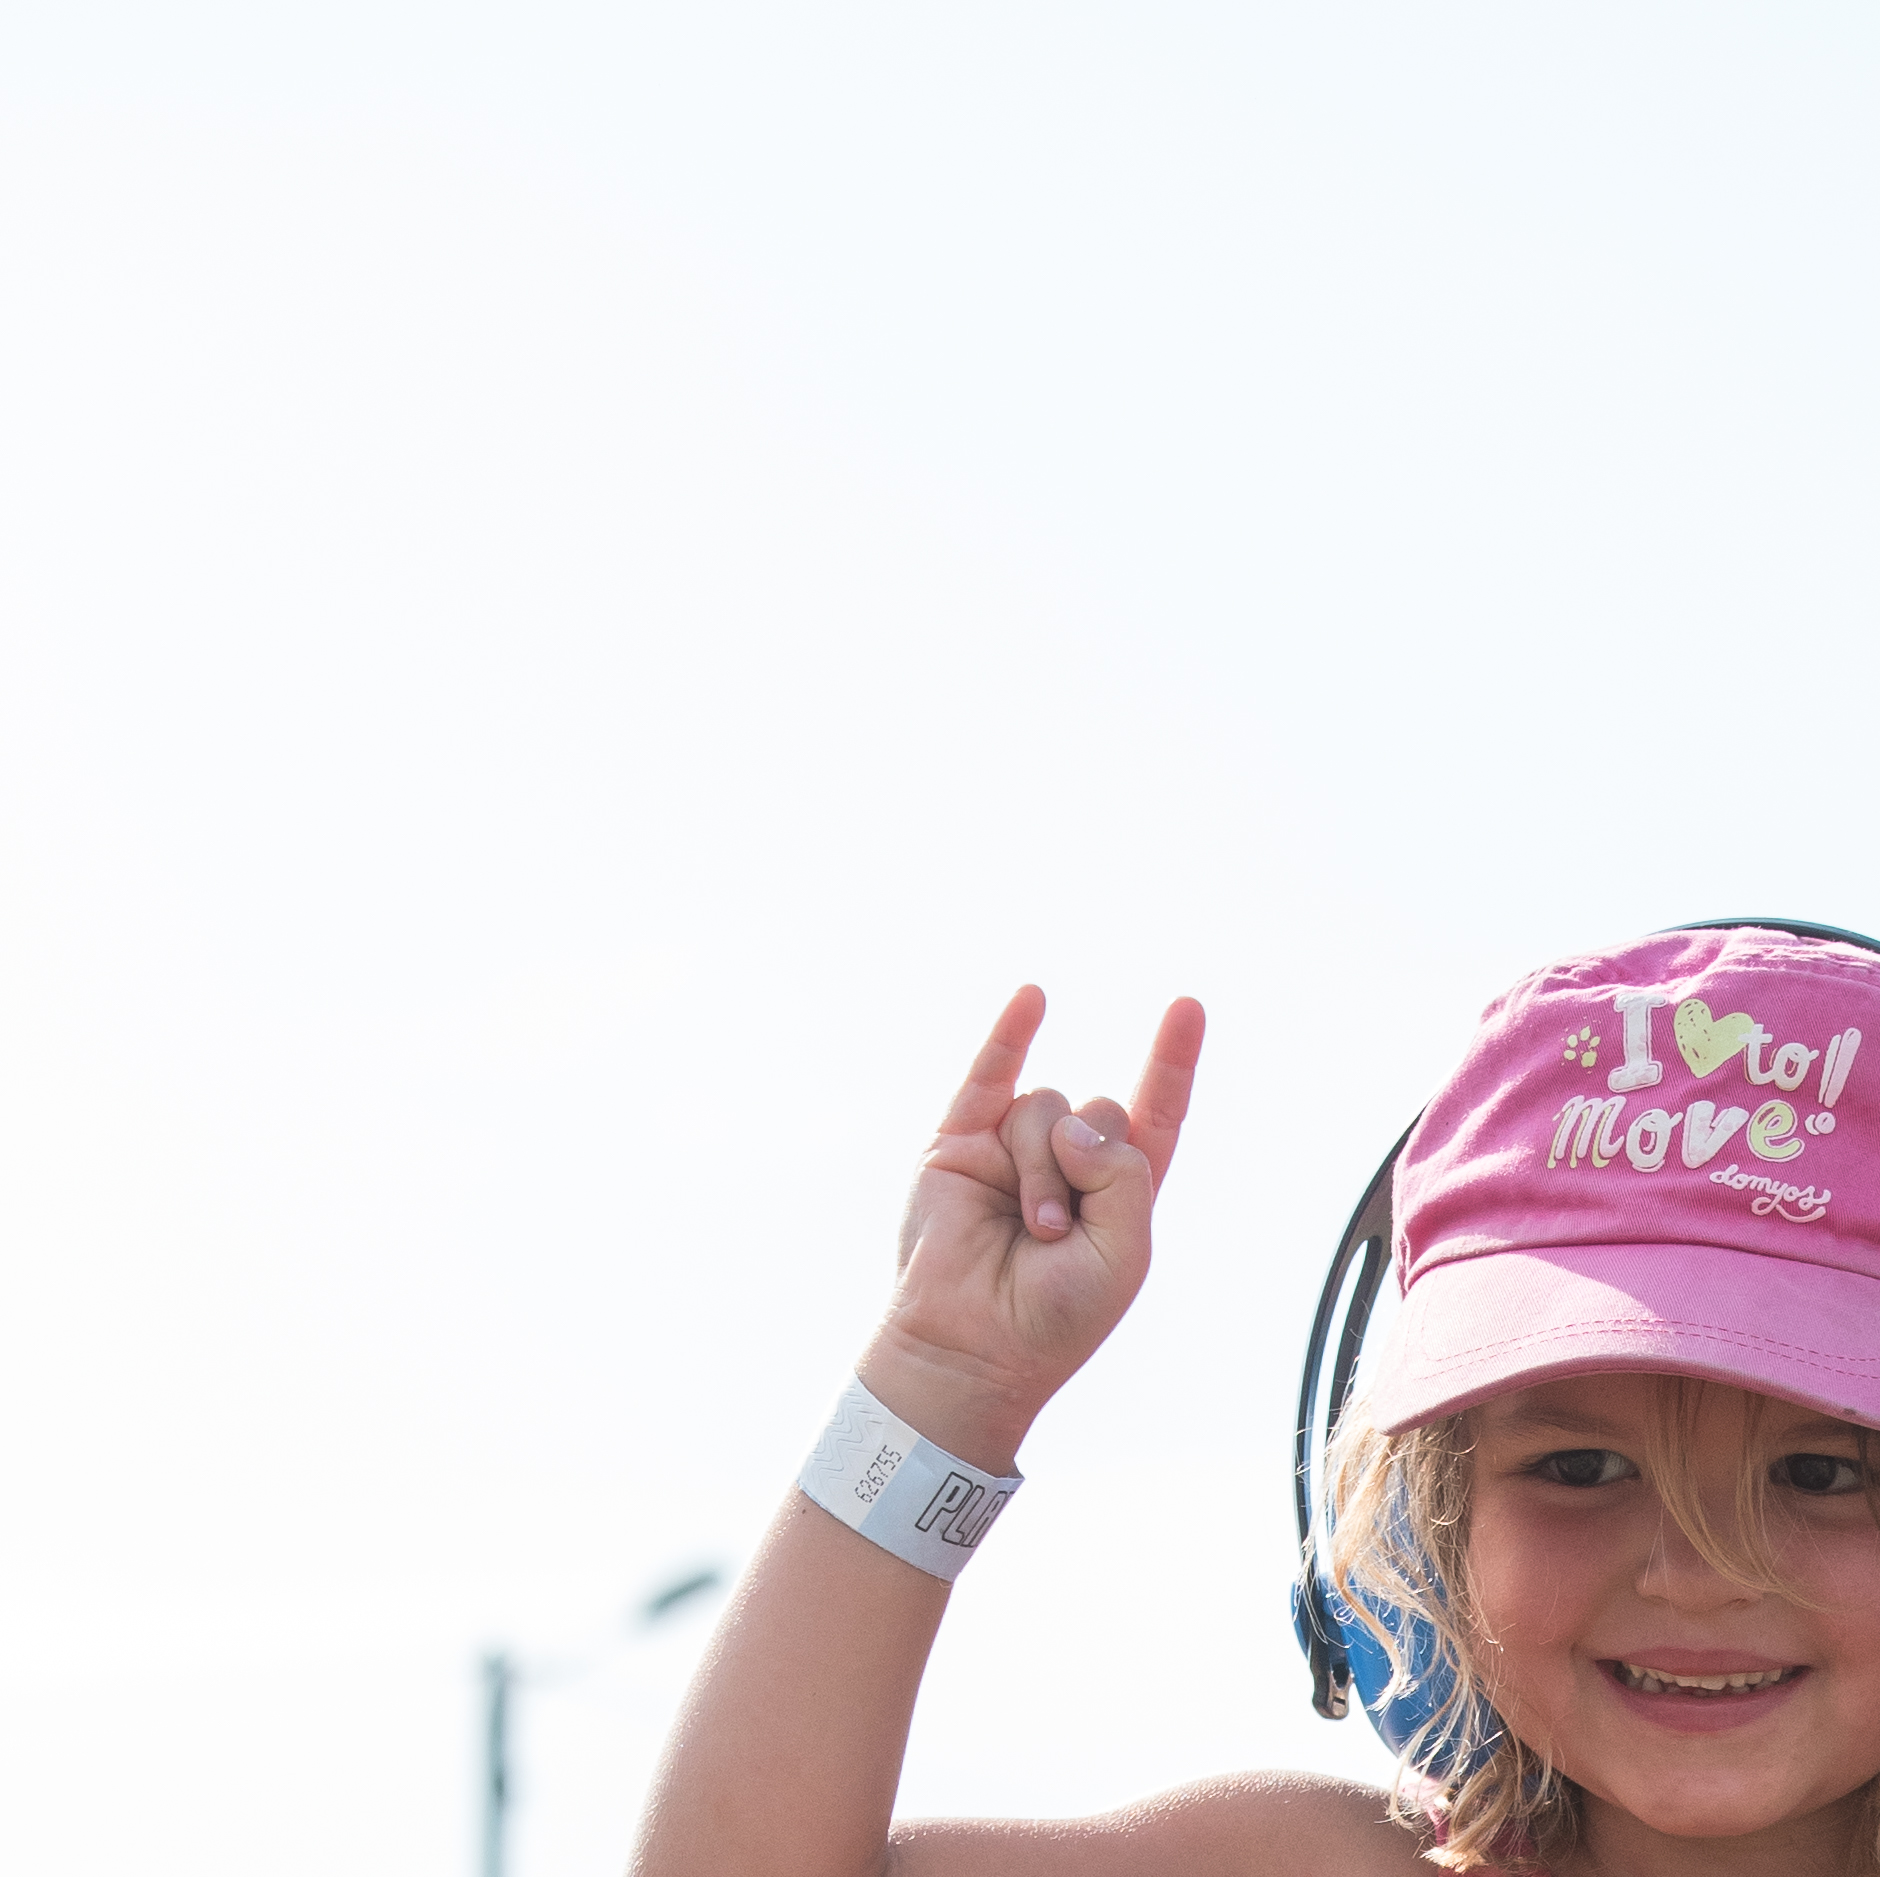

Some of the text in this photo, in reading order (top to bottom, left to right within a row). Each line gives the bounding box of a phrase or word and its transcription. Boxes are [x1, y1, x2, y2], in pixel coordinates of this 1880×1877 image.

[1607, 993, 1668, 1092] I
[1709, 1163, 1832, 1224] domyos
[854, 1444, 903, 1504] 626755
[914, 1470, 1015, 1549] PLA
